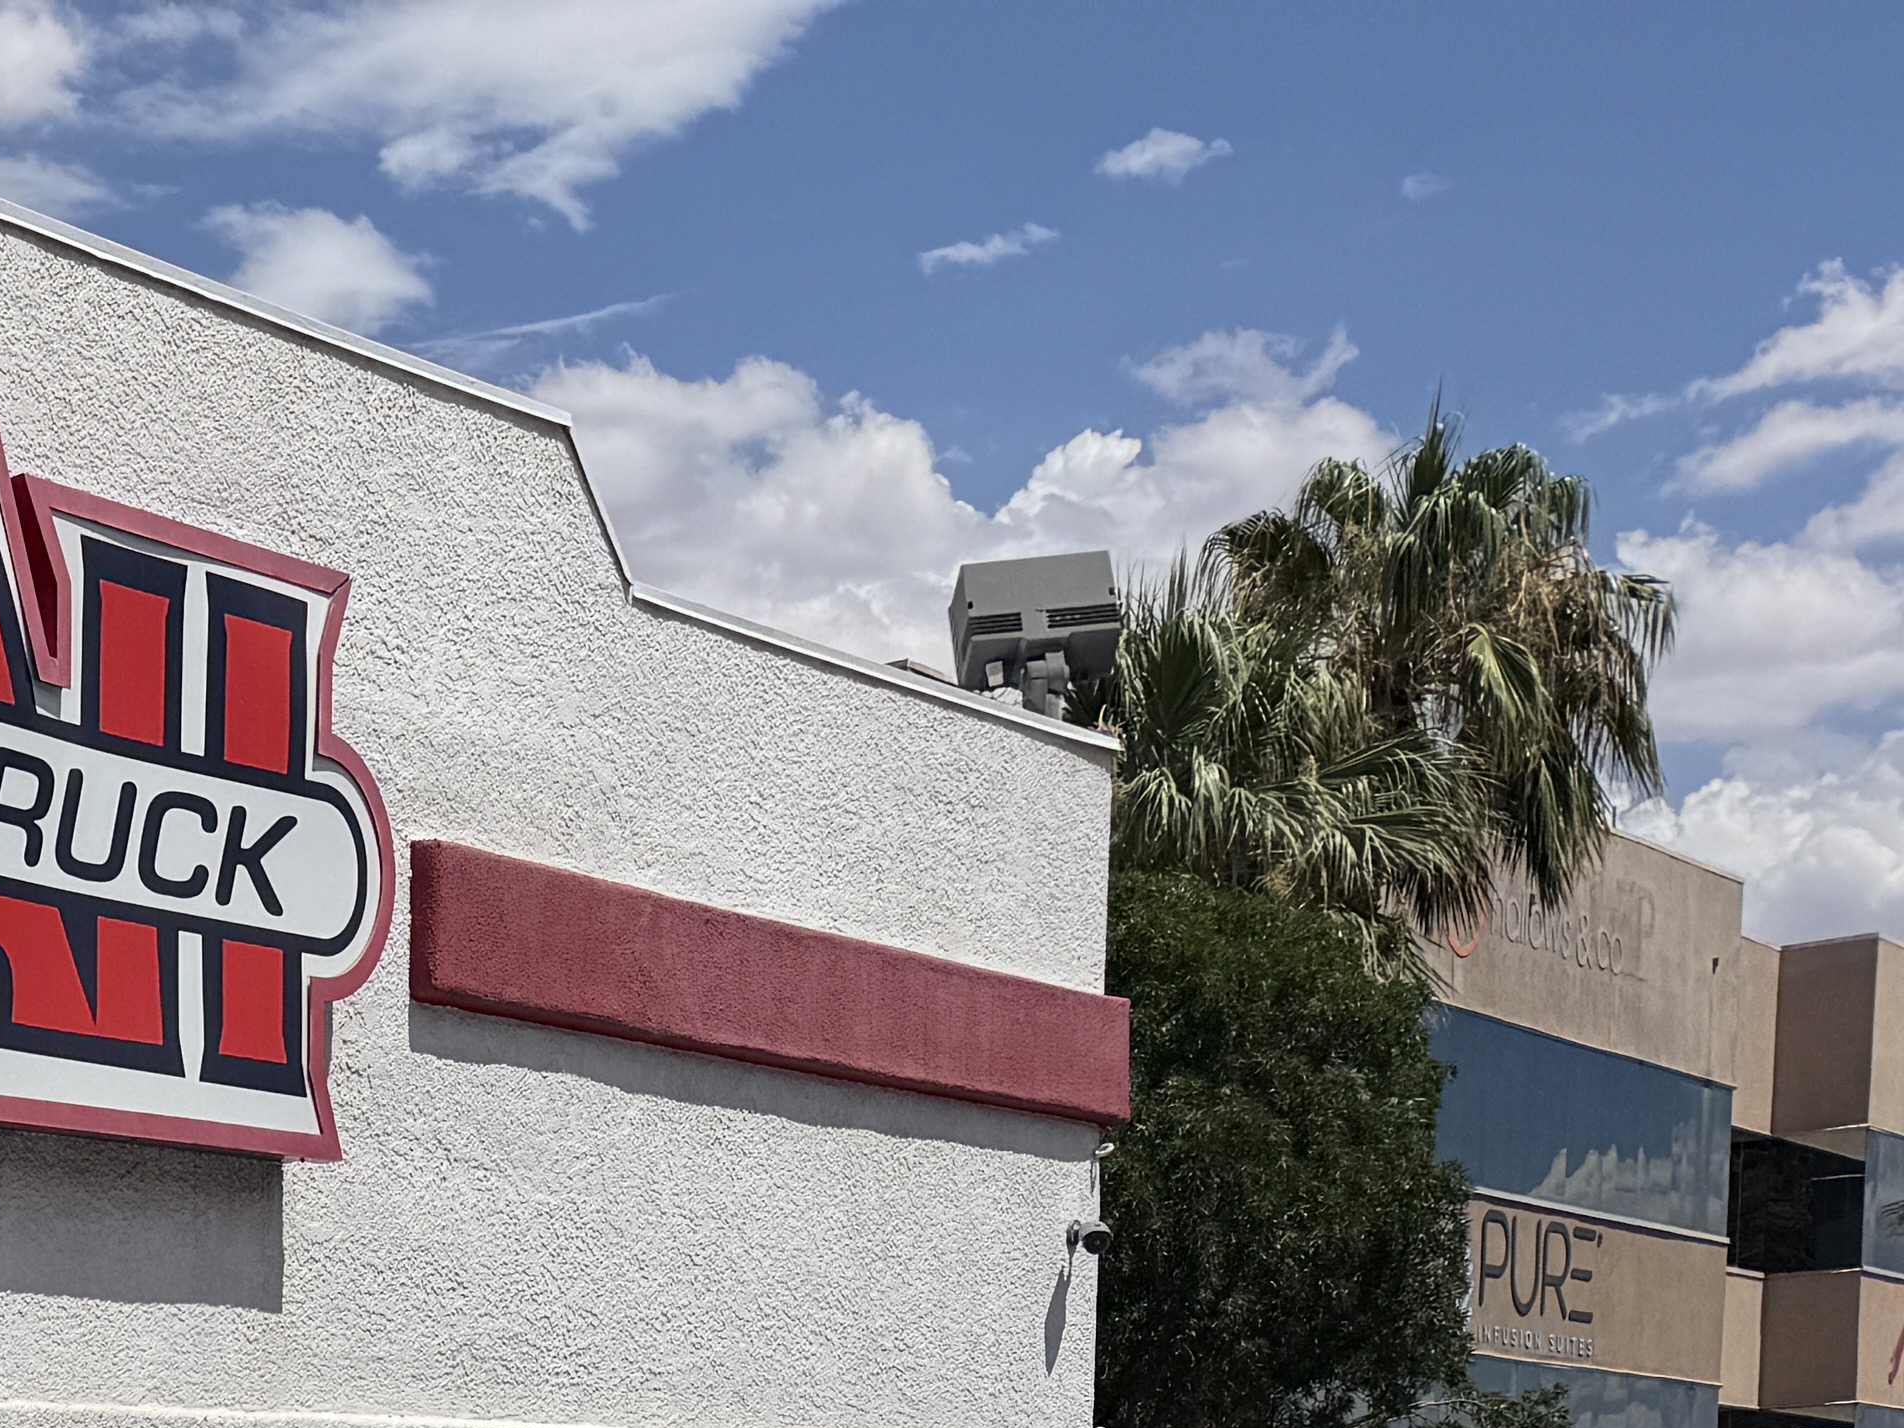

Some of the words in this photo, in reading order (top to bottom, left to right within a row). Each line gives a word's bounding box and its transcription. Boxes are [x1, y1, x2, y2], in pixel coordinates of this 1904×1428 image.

[1478, 1209, 1594, 1325] PURE
[1476, 1324, 1542, 1352] INFUSION
[1548, 1333, 1594, 1359] SUITES
